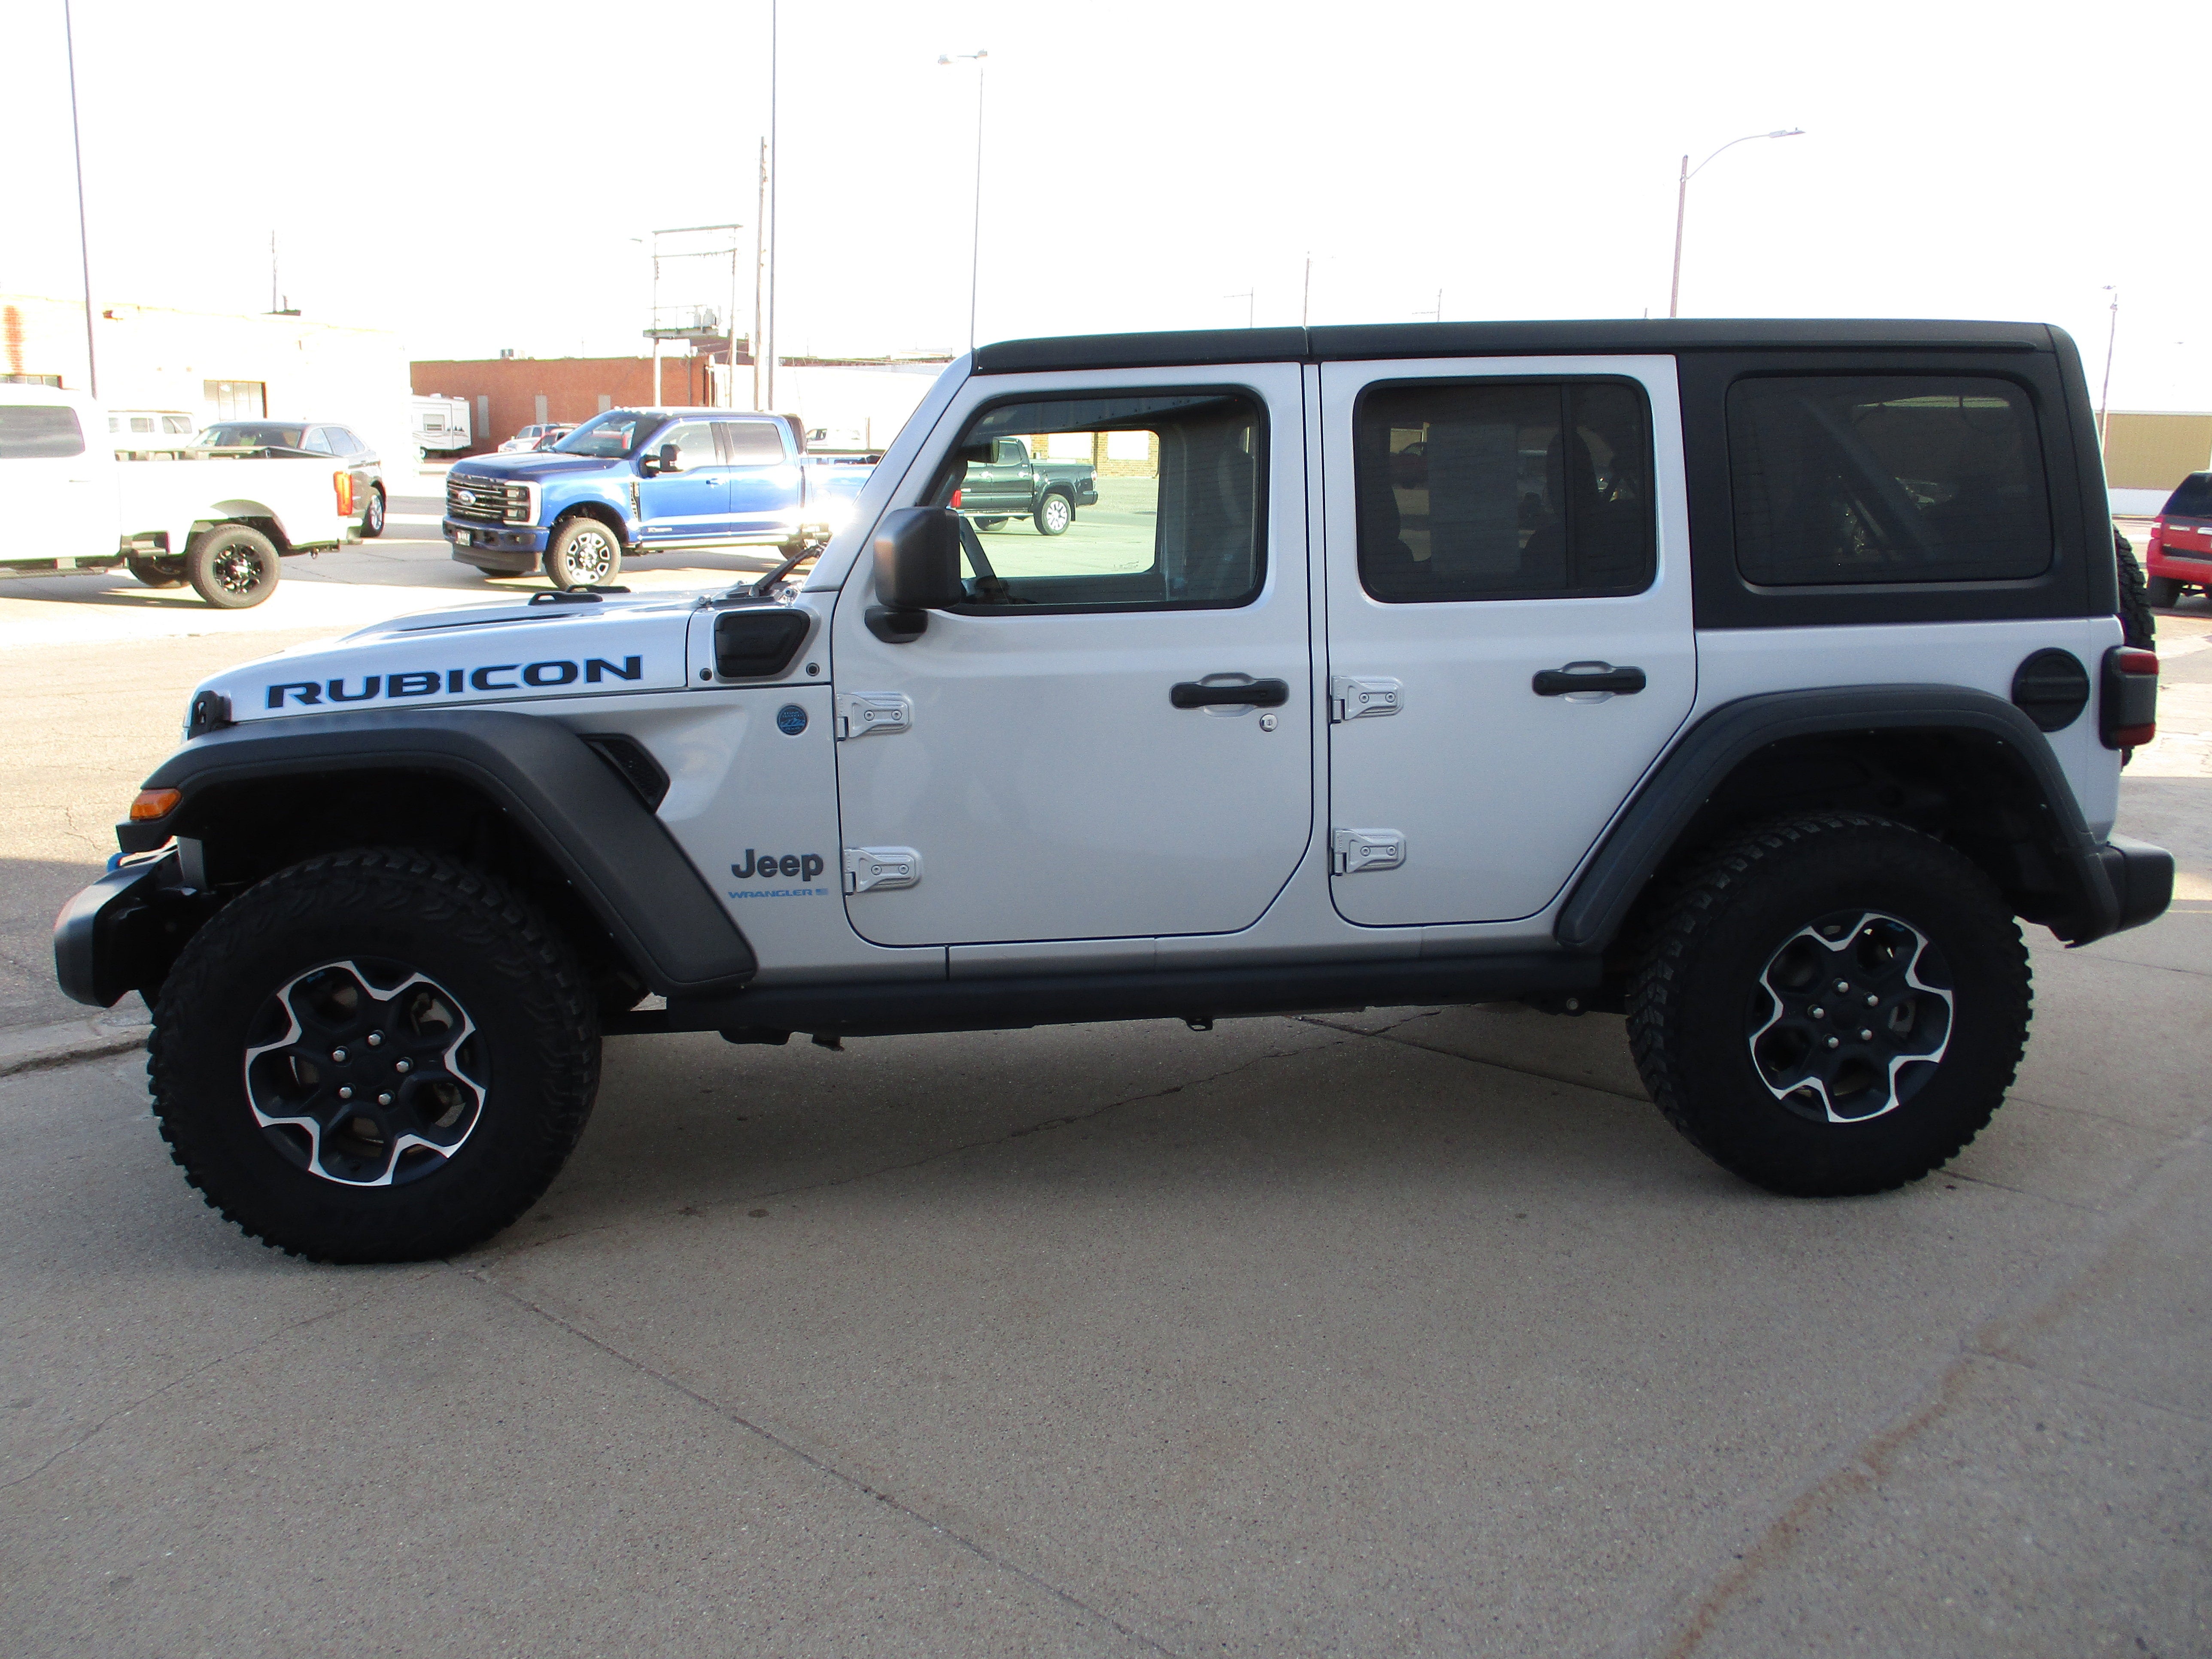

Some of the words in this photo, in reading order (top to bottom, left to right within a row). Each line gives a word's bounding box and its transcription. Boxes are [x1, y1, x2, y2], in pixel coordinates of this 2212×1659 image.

[265, 655, 643, 709] RUBICON
[731, 848, 823, 881] Jeep
[728, 889, 813, 899] WRANGLER
